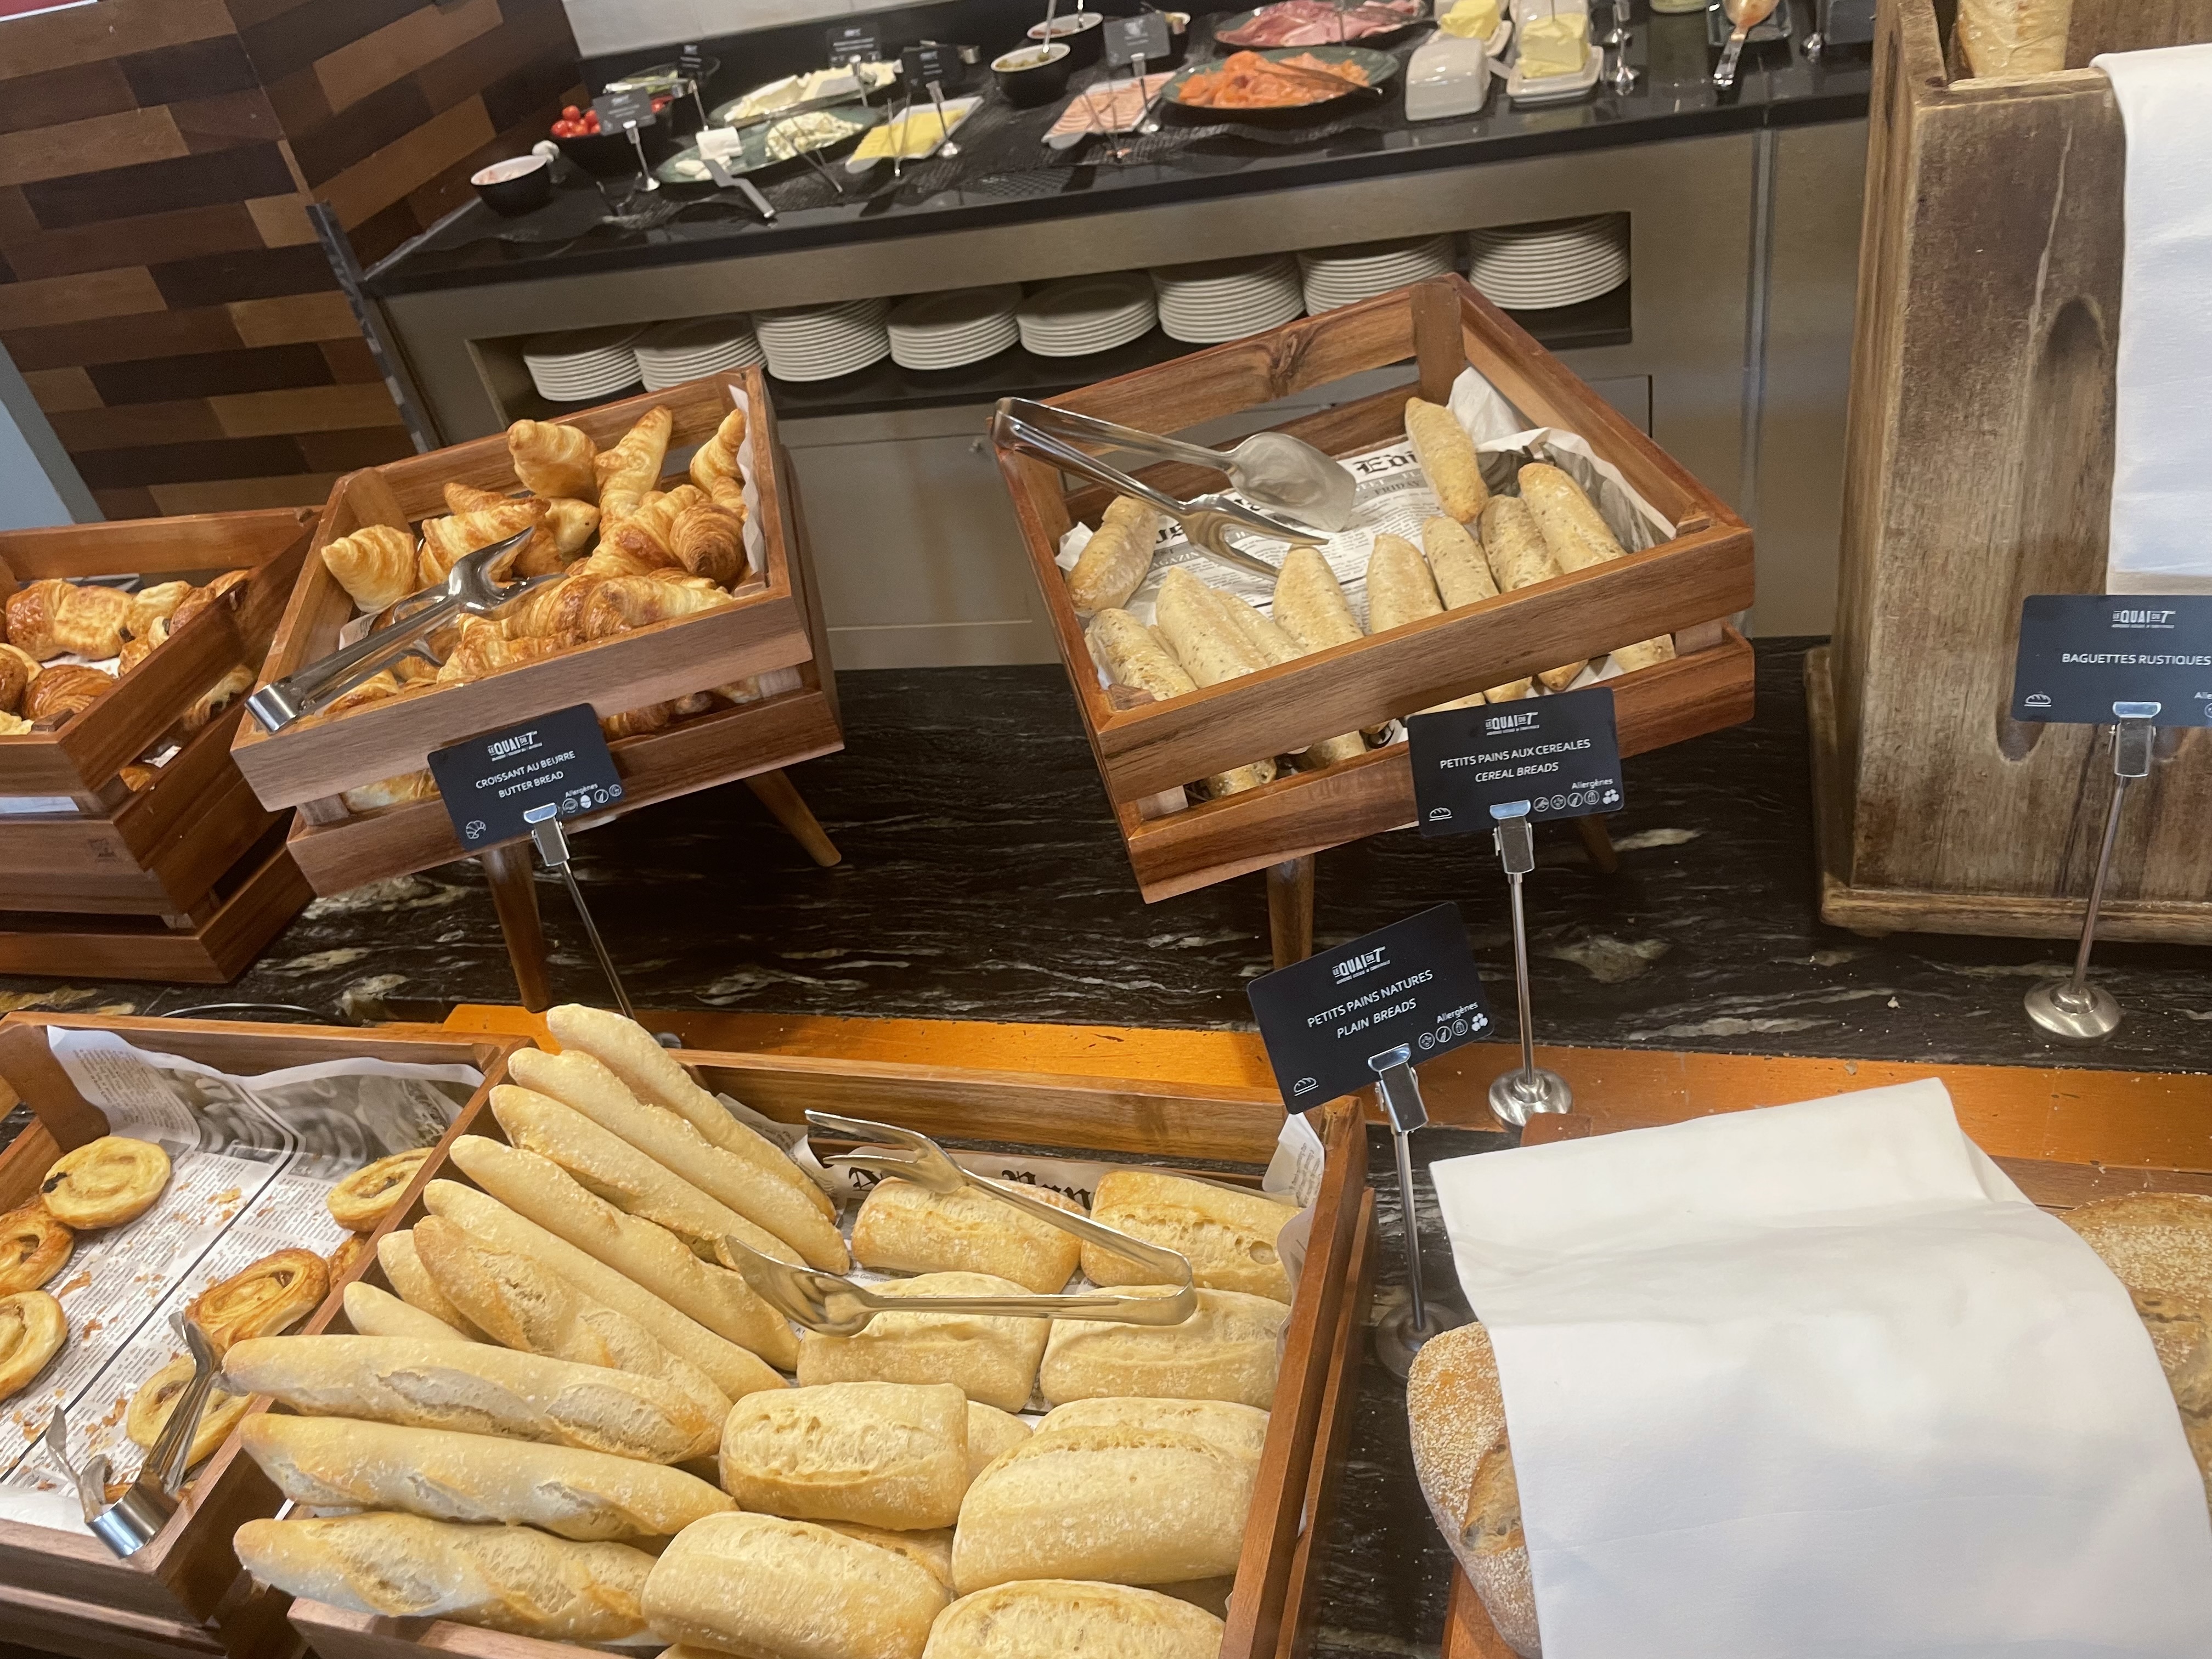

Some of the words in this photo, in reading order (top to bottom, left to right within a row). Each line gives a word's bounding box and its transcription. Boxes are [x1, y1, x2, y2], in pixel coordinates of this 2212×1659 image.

[2120, 610, 2151, 623] QUAI
[2062, 653, 2136, 664] BAGUETTES
[2138, 655, 2211, 665] RUSTIQUES
[1492, 715, 1518, 730] QUAI
[494, 737, 520, 755] QUAI
[1440, 755, 1476, 769] PETITS
[1478, 751, 1510, 763] PAINS
[1511, 747, 1534, 759] AUX
[1535, 738, 1591, 755] CEREALES
[476, 766, 526, 789] CROISSANT
[527, 762, 539, 773] AU
[540, 751, 575, 769] BEURRE
[1475, 770, 1514, 782] CEREAL
[1517, 761, 1559, 776] BREADS
[498, 780, 533, 798] BUTTER
[533, 771, 564, 787] BREAD
[1571, 777, 1613, 790] Allergènes
[1339, 955, 1367, 976] QUAI
[1307, 1005, 1346, 1028] PETITS
[1346, 991, 1380, 1012] PAINS
[1380, 969, 1433, 998] NATURES
[1337, 1017, 1369, 1038] PLAIN
[1373, 998, 1417, 1024] BREADS
[1437, 1002, 1479, 1024] Allergènes
